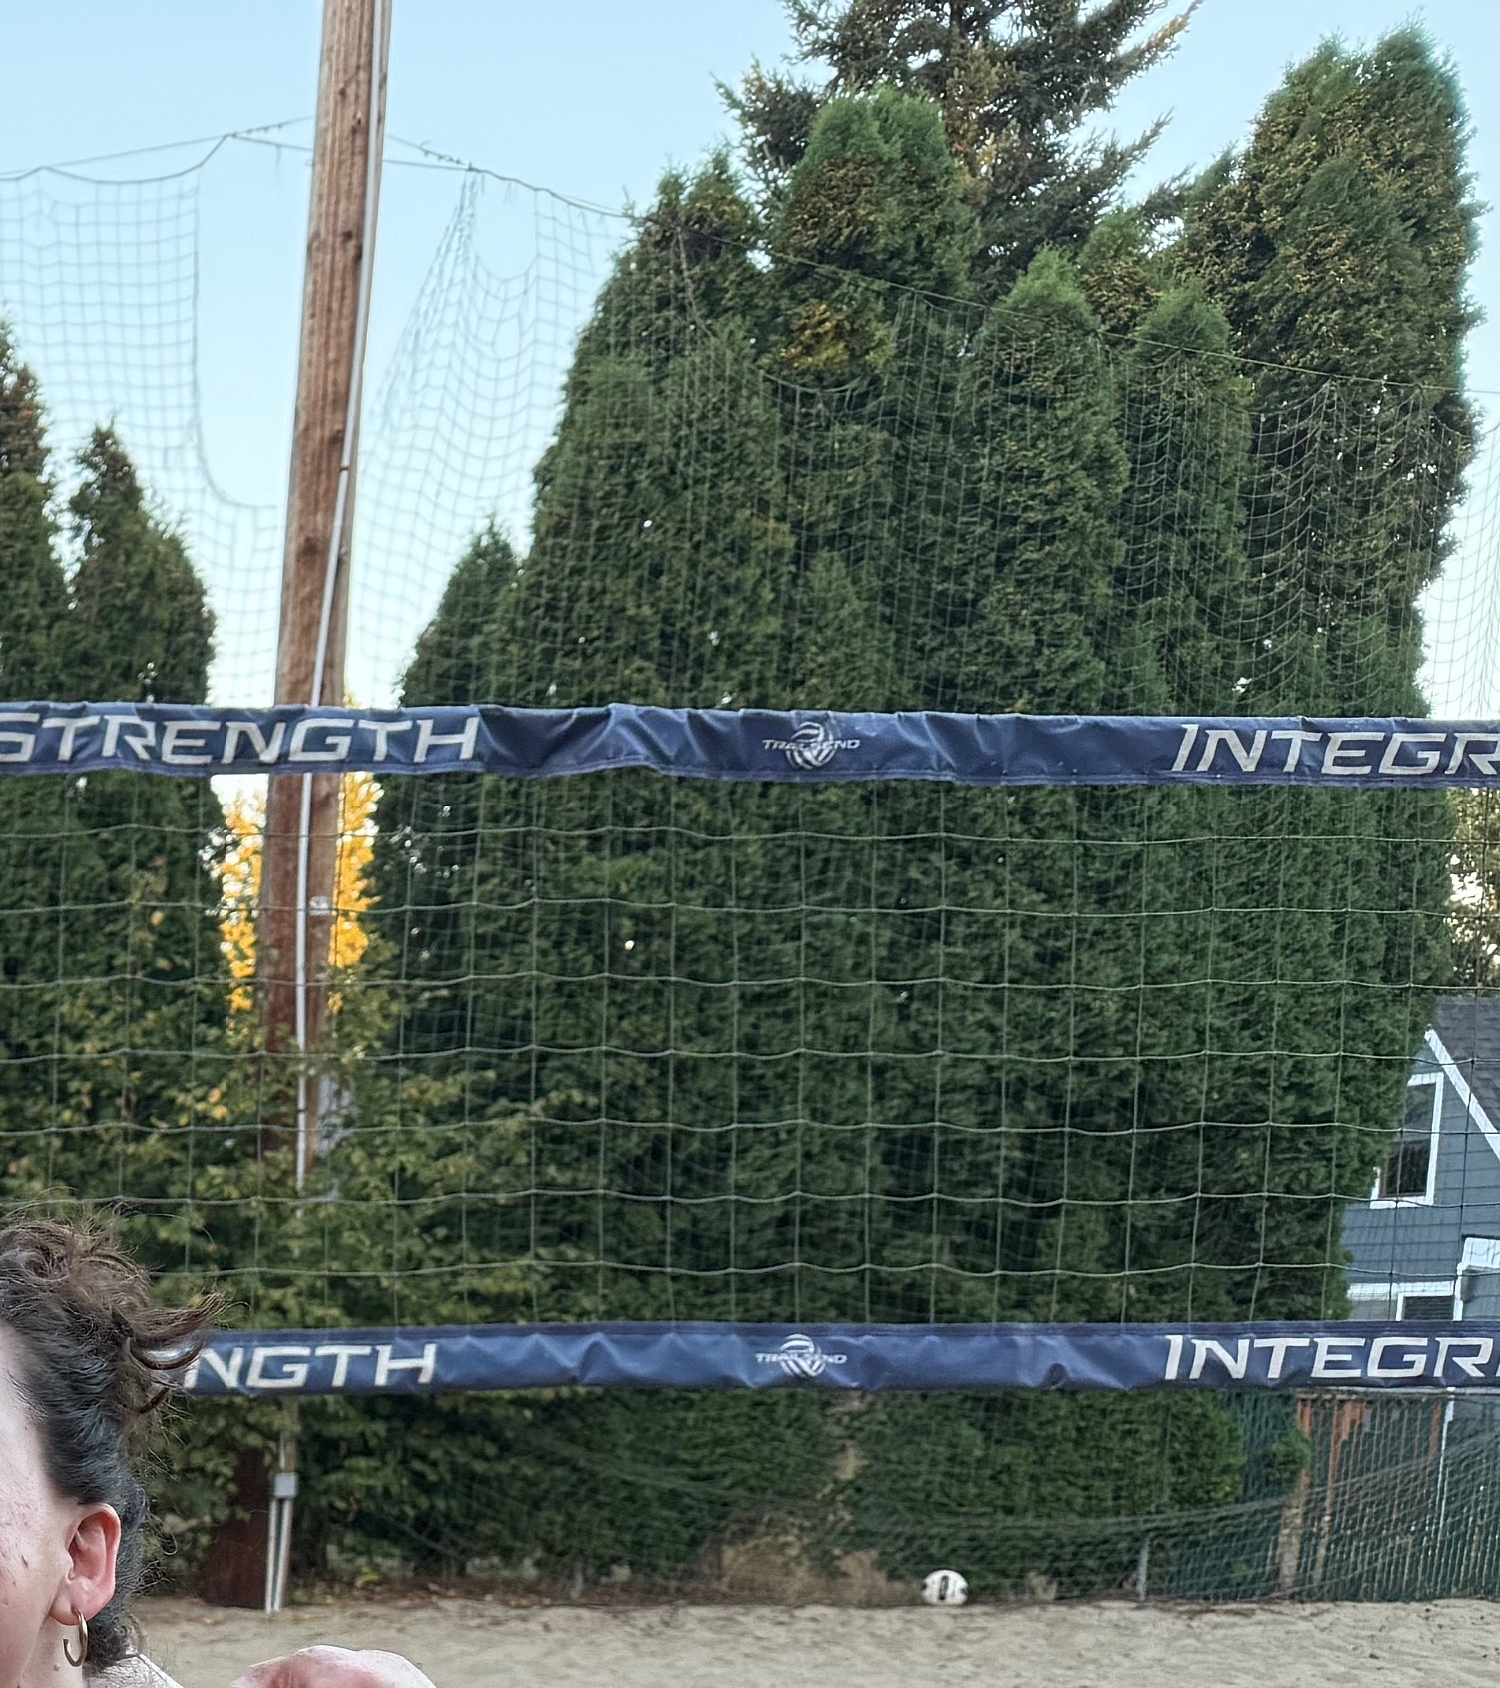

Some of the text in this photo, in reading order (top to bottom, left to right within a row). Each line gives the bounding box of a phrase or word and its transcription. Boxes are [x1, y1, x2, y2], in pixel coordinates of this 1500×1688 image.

[1171, 724, 1500, 775] INTEGR
[184, 1343, 438, 1389] NGTH
[1164, 1335, 1500, 1380] INTEGR
